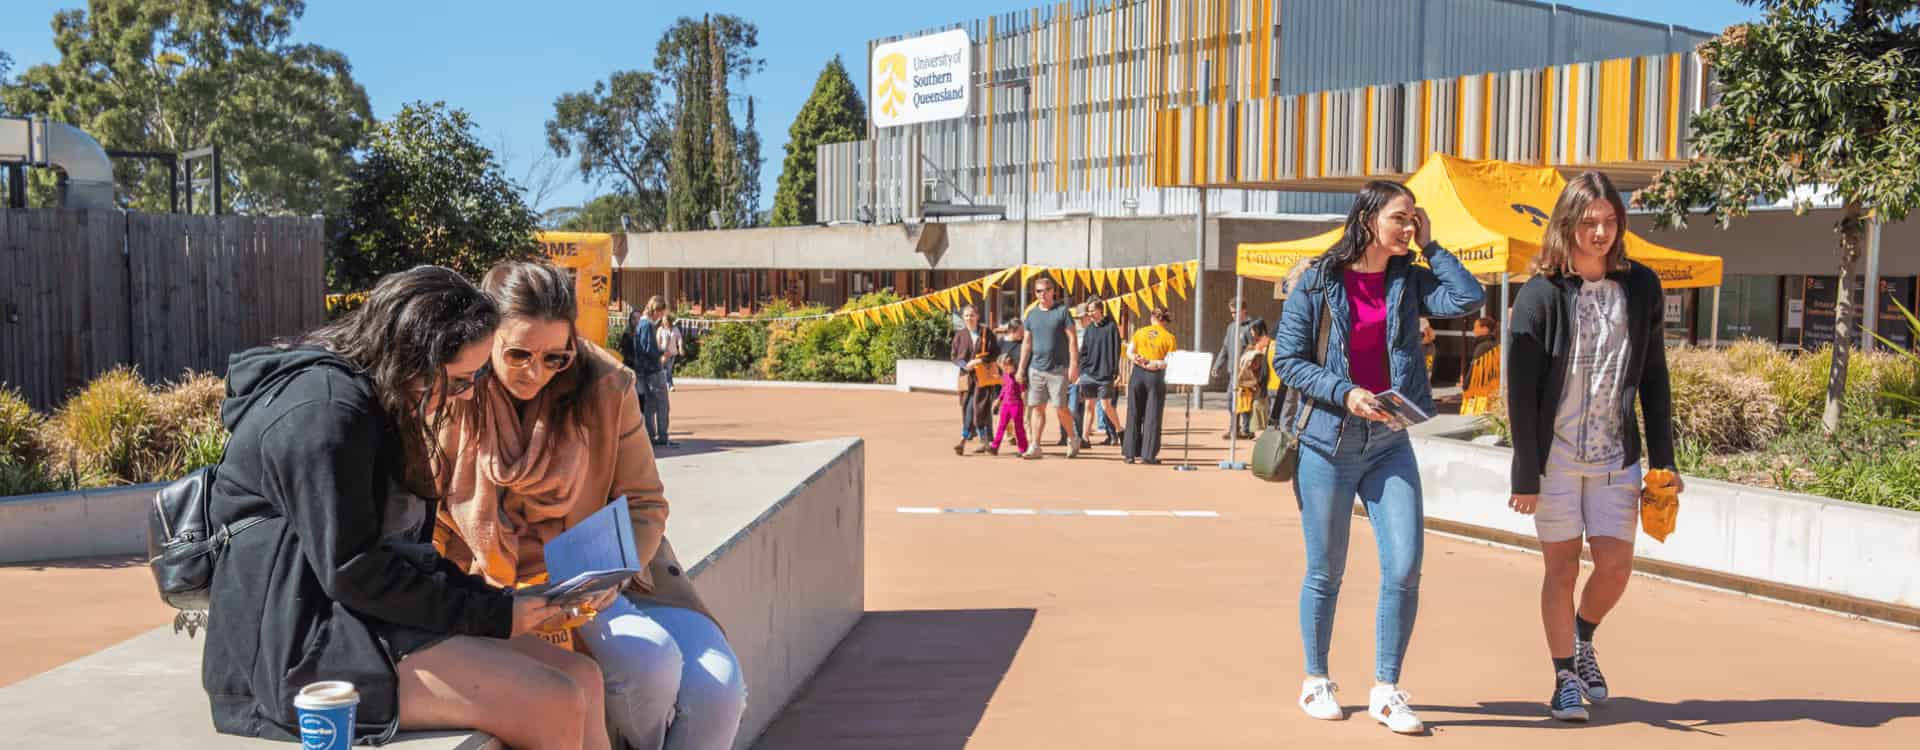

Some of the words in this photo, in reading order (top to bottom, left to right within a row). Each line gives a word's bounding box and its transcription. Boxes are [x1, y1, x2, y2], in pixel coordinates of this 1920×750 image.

[913, 53, 952, 70] University
[953, 48, 962, 64] of
[913, 72, 952, 88] Southern
[913, 85, 964, 109] Queensland
[538, 242, 577, 257] OME
